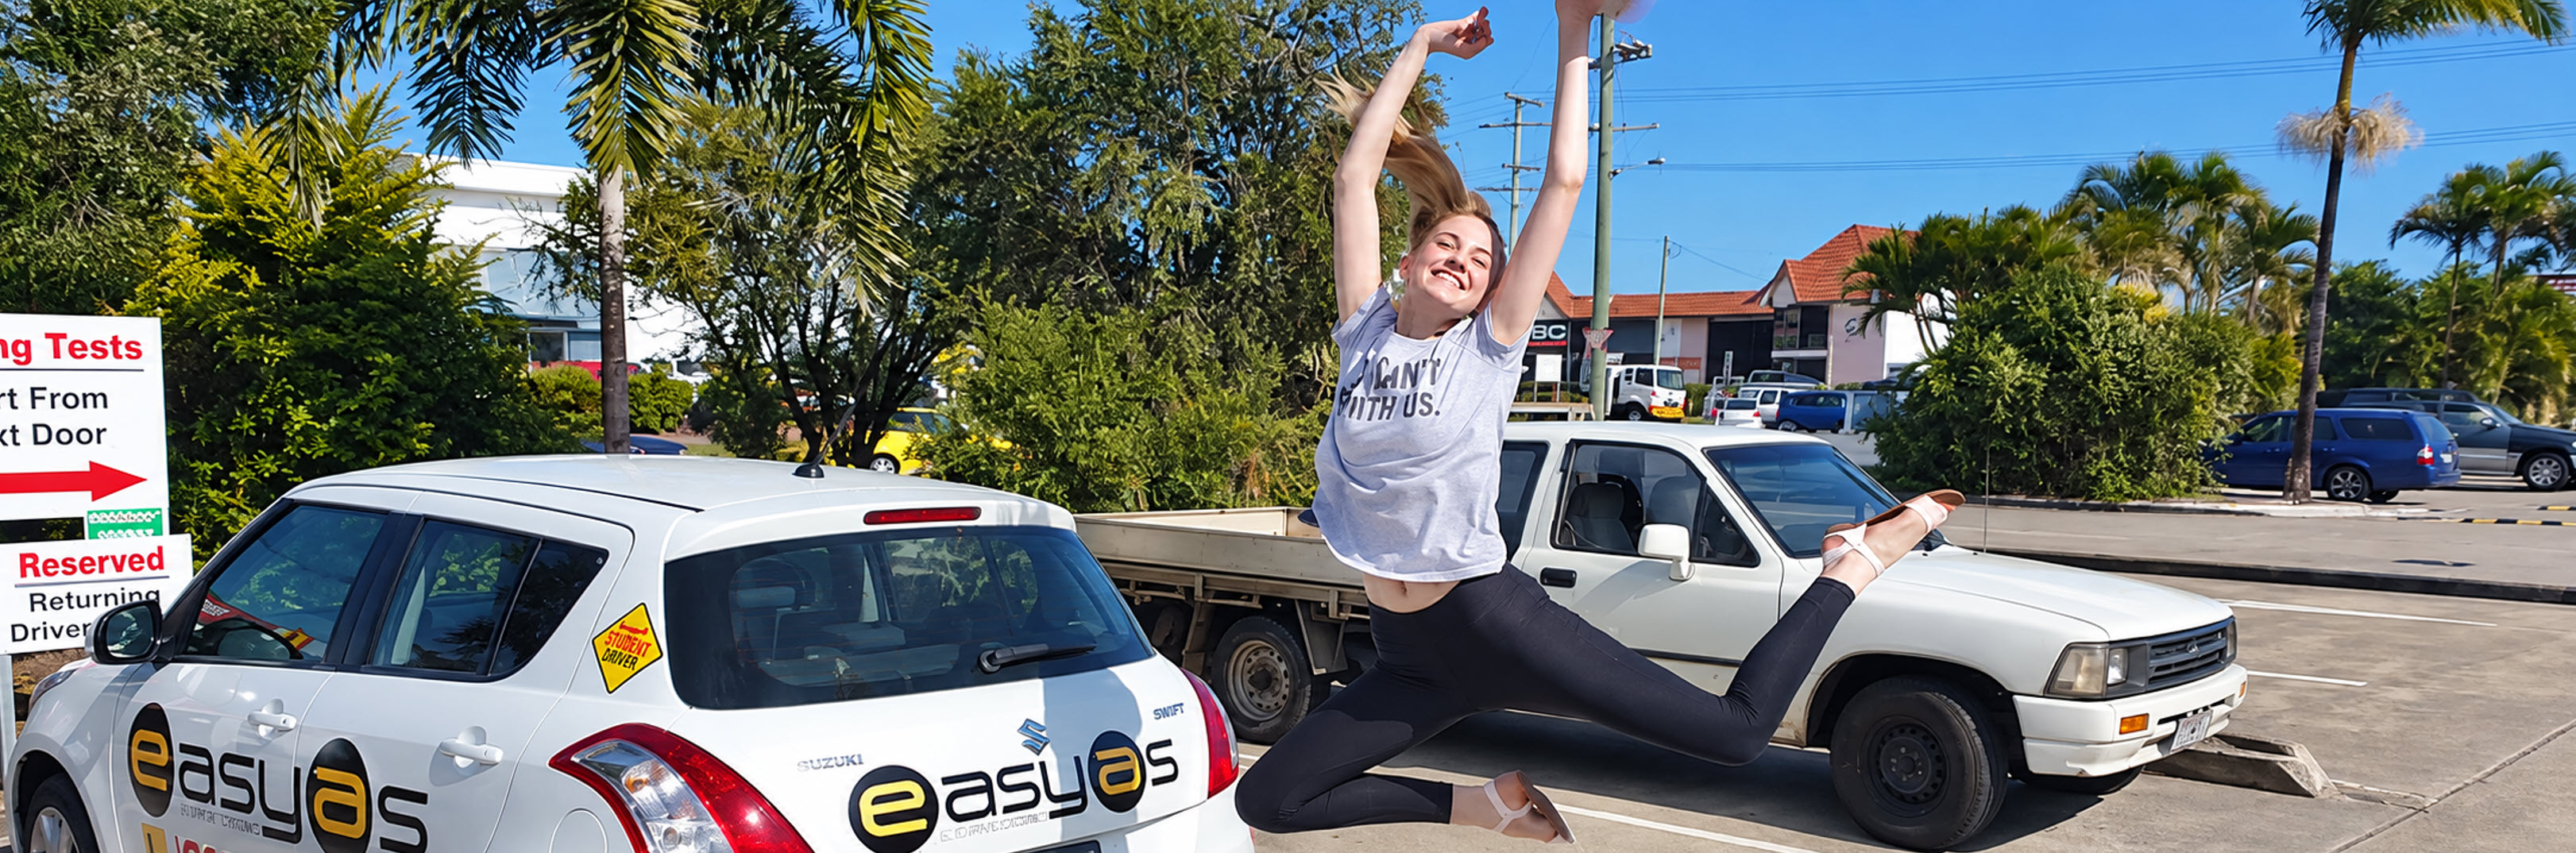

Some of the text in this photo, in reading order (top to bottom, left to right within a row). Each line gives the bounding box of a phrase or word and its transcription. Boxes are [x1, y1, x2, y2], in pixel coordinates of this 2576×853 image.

[44, 332, 143, 361] Tests
[30, 386, 109, 410] From
[1403, 392, 1441, 418] US.
[32, 423, 107, 446] Door
[19, 545, 164, 578] Reserved
[604, 630, 652, 658] STUDENT
[601, 647, 639, 671] DRIVER
[1153, 702, 1184, 720] SWIFT
[797, 753, 864, 773] SUZUKI
